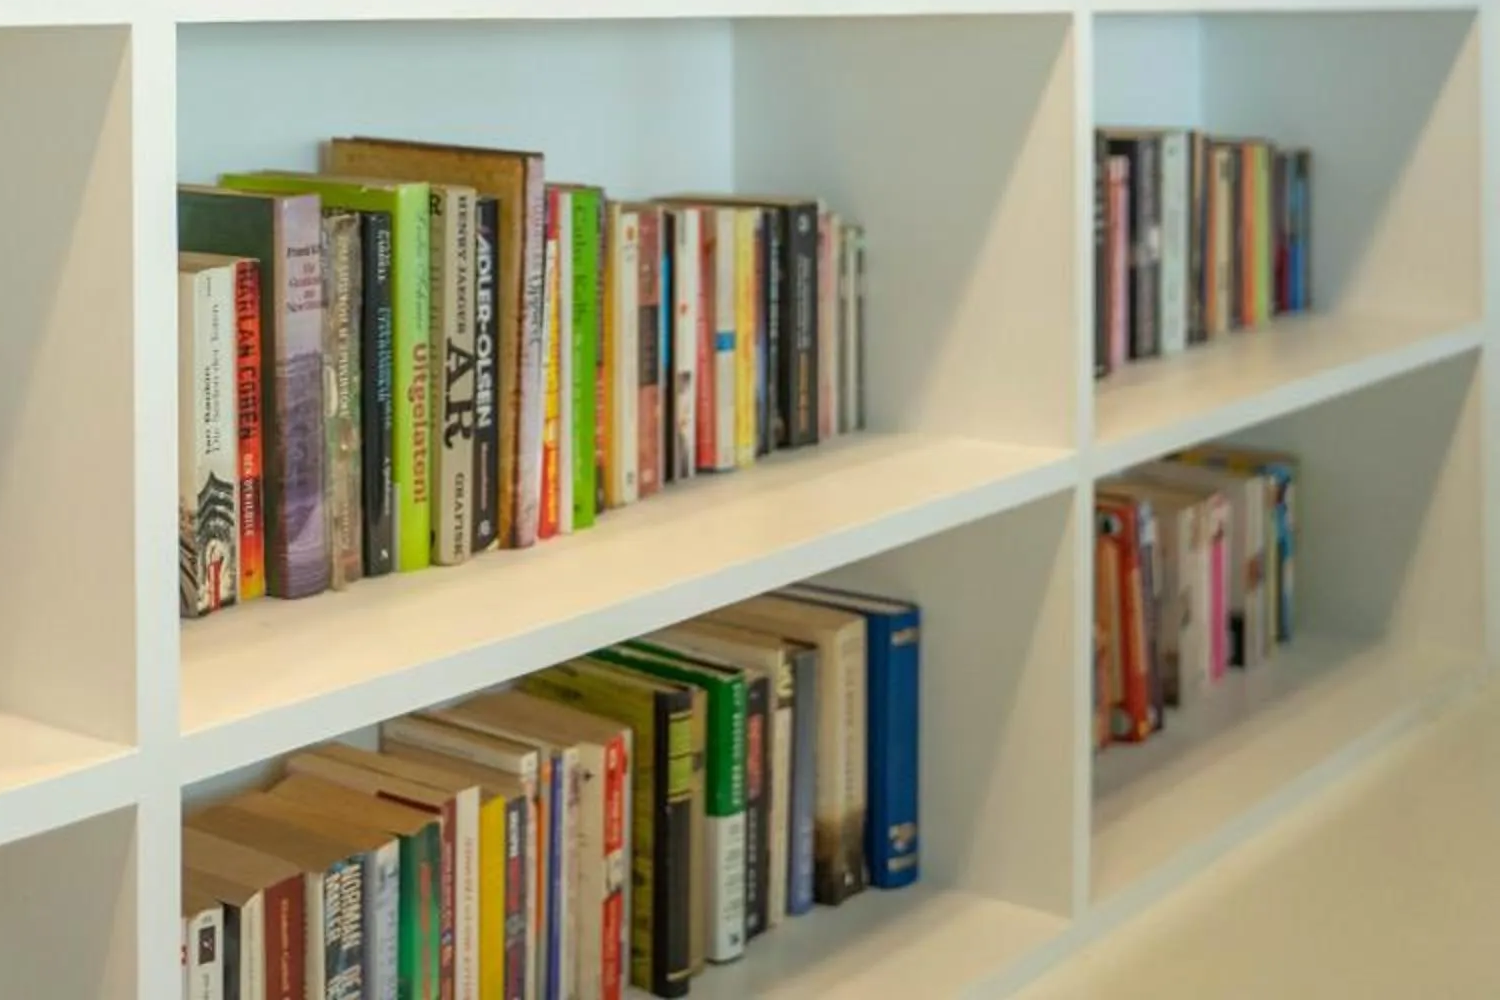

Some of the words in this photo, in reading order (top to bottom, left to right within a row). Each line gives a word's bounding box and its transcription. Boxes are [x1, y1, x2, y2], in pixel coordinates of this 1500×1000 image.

[237, 264, 260, 363] HARLAN
[475, 234, 492, 428] ADLER-OLSEN
[239, 367, 261, 440] COBEN
[407, 342, 429, 503] Uitgelaten!
[341, 863, 362, 951] NORMAN
